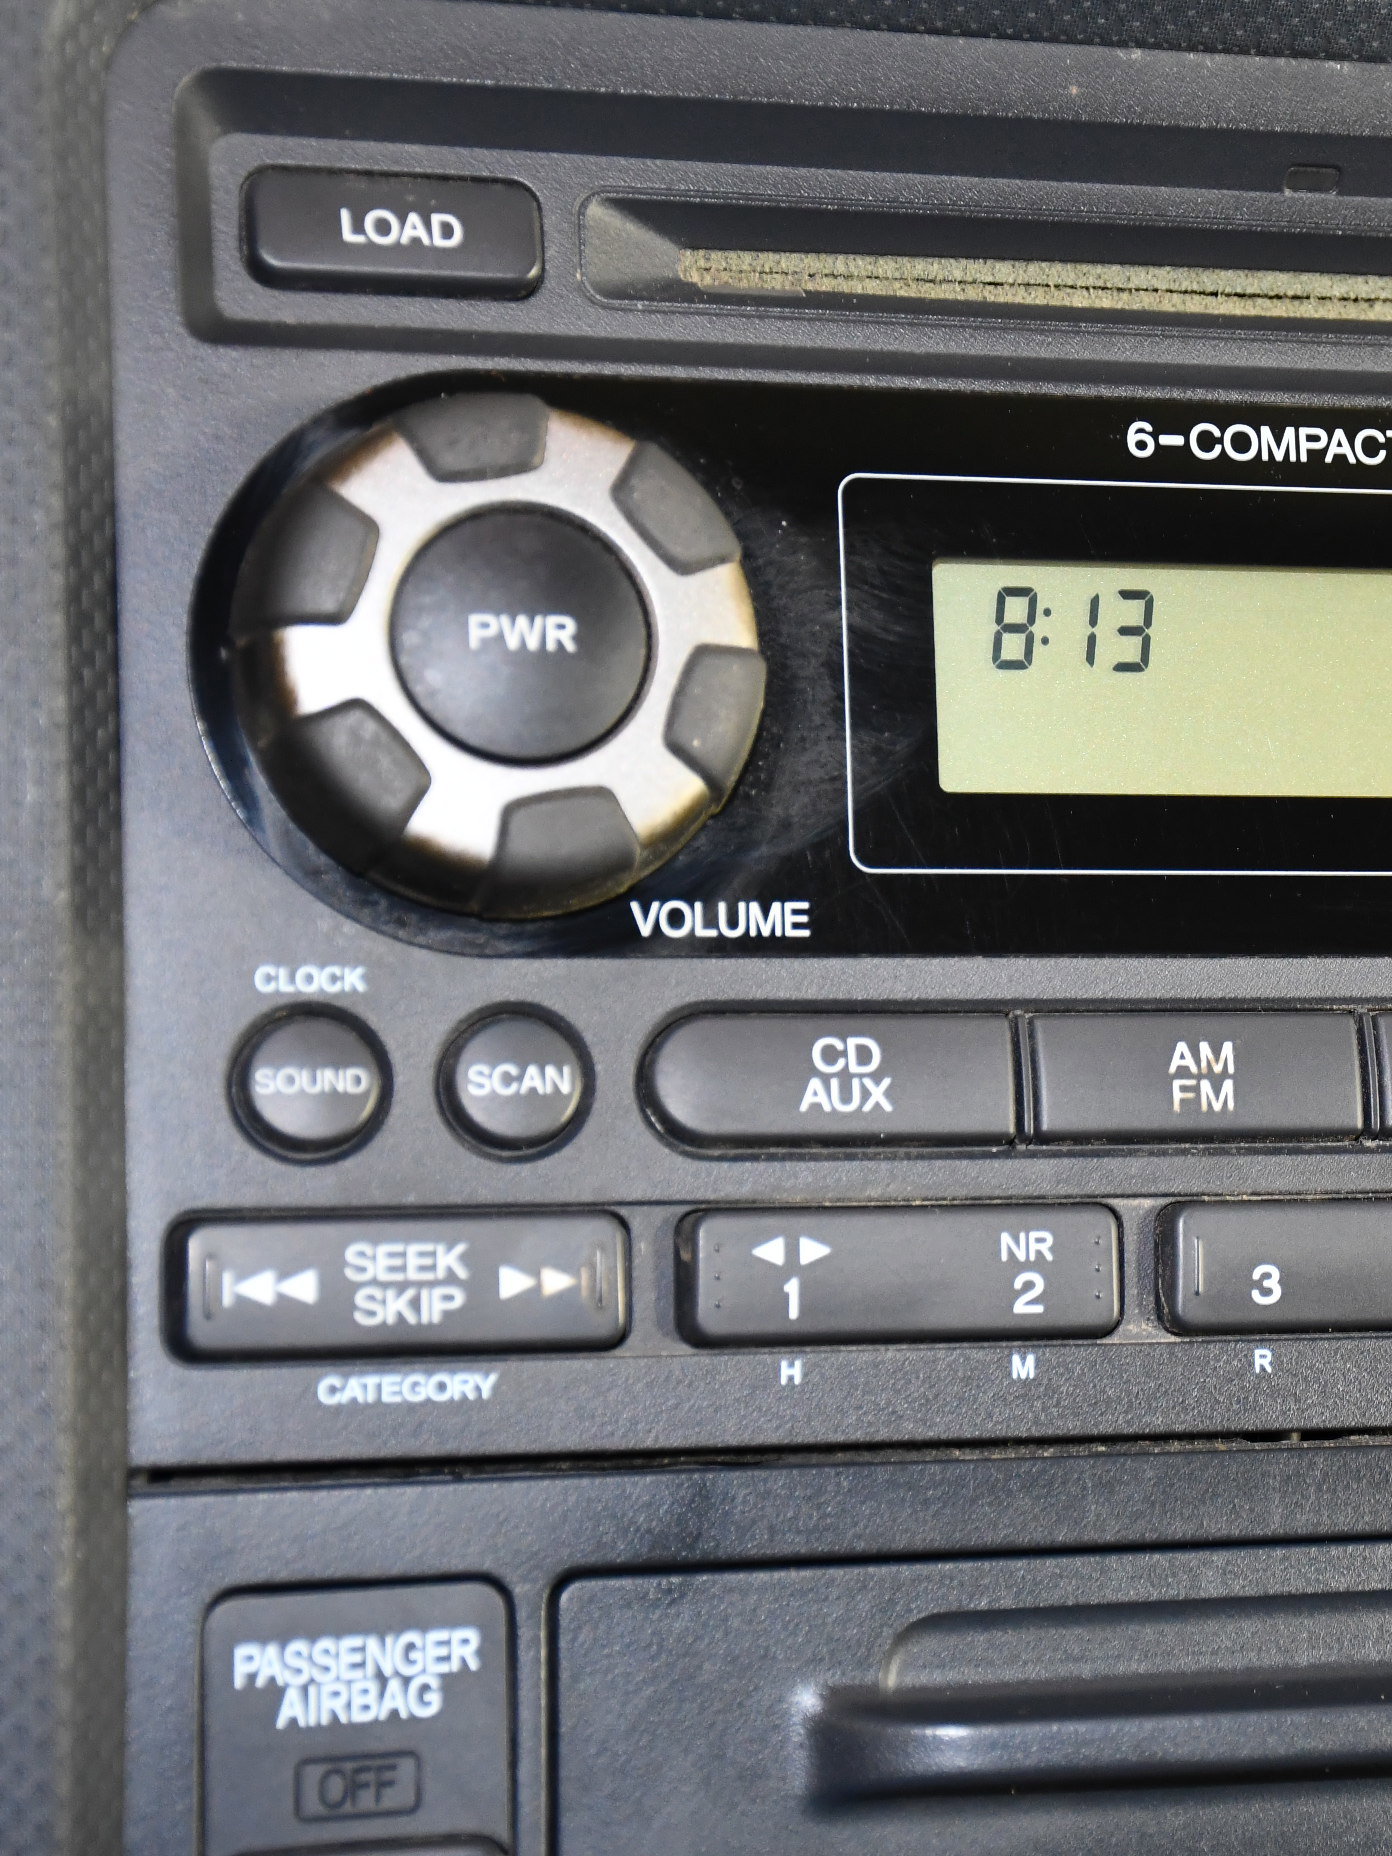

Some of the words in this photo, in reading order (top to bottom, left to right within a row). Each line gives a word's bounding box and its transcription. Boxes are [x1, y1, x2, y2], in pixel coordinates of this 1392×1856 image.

[340, 207, 464, 249] LOAD
[468, 613, 577, 653] PWR
[991, 586, 1154, 673] 8:13
[630, 901, 811, 938] VOLUME
[254, 966, 366, 994] CLOCK
[811, 1036, 881, 1075] CD
[1169, 1041, 1236, 1075] AM
[254, 1067, 368, 1095] SOUND
[467, 1064, 572, 1096] SCAN
[799, 1078, 892, 1112] AUX
[1173, 1079, 1236, 1113] FM
[344, 1242, 469, 1282] SEEK
[1001, 1231, 1054, 1262] NR
[783, 1277, 801, 1320] 1
[1013, 1272, 1044, 1314] 2
[1251, 1264, 1281, 1306] 3
[353, 1285, 466, 1326] SKIP
[780, 1360, 802, 1385] H
[1011, 1354, 1035, 1379] M
[1254, 1349, 1273, 1374] R
[317, 1372, 498, 1406] CATEGORY
[233, 1626, 482, 1690] PASSENGER
[275, 1674, 443, 1729] AIRBAG
[318, 1763, 397, 1811] OFF
